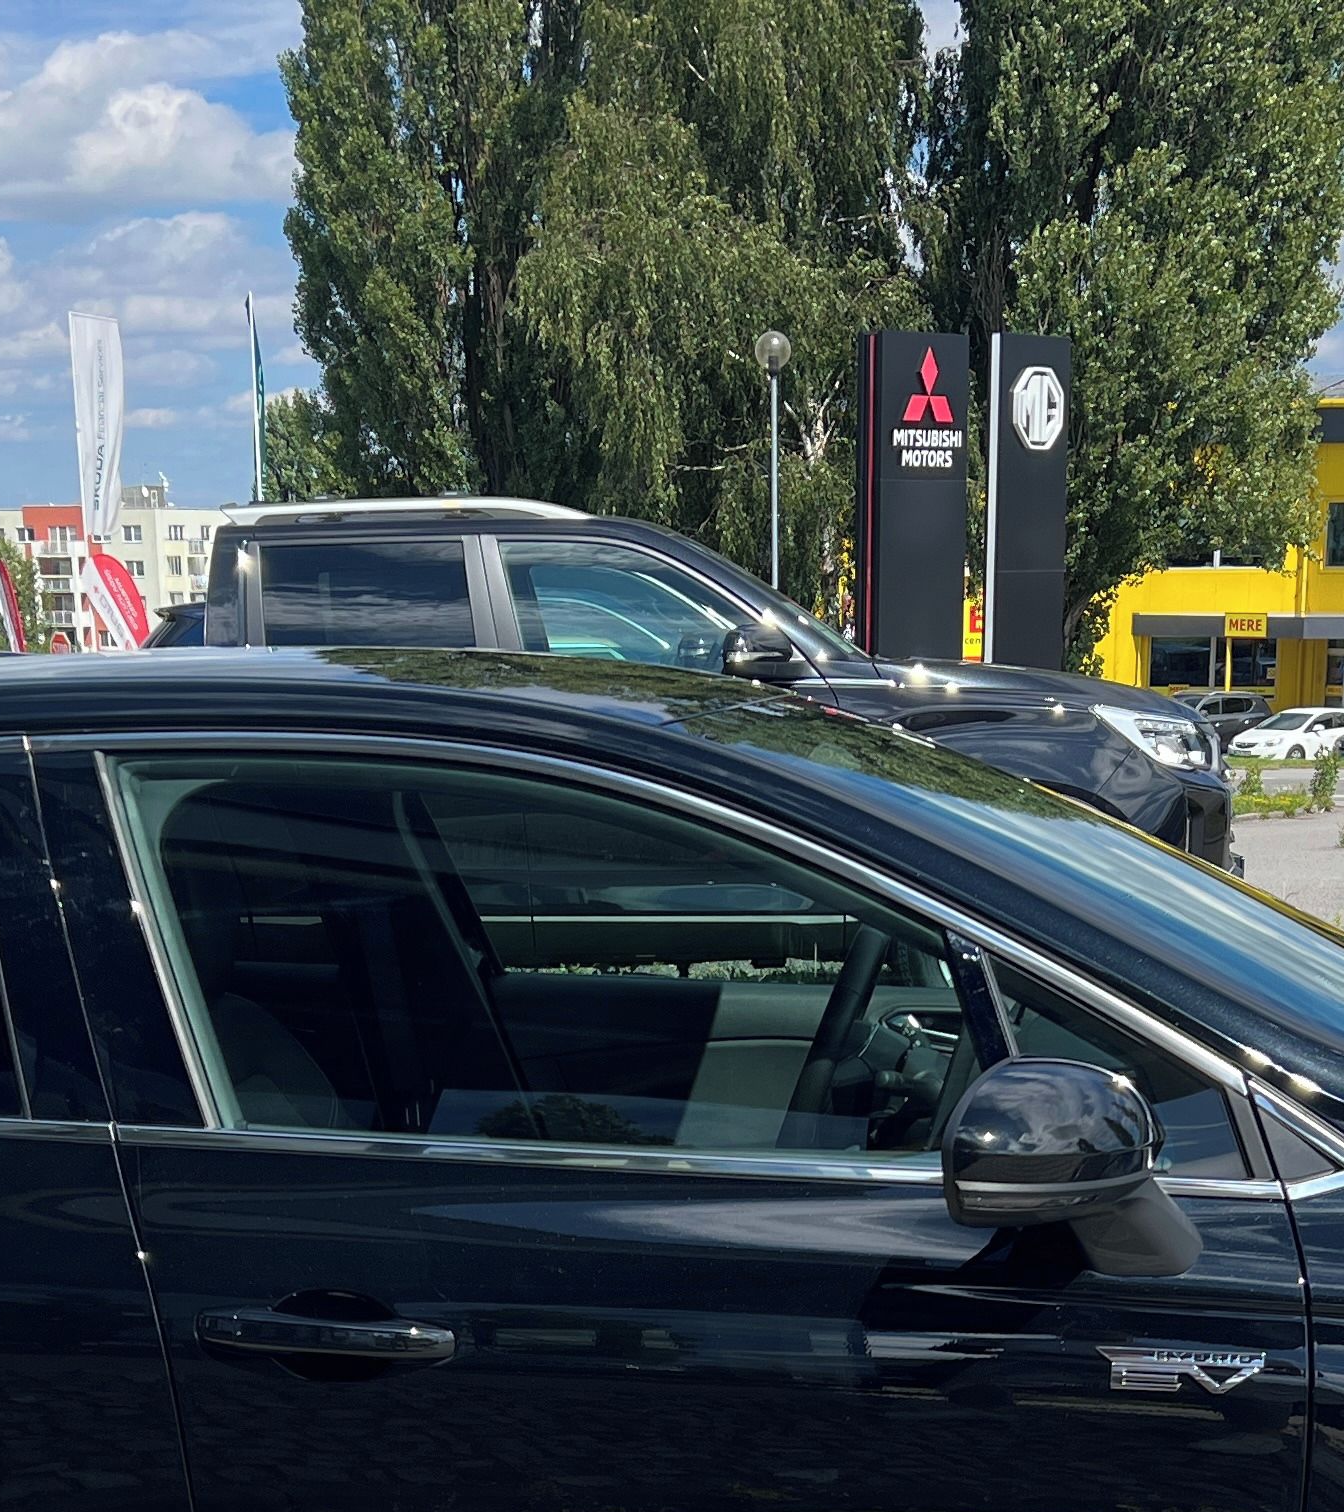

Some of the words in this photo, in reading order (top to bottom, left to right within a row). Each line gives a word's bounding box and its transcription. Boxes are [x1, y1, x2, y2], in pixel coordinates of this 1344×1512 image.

[893, 429, 962, 448] MITSUBISHI
[901, 450, 953, 468] MOTORS
[1229, 618, 1262, 632] MERE
